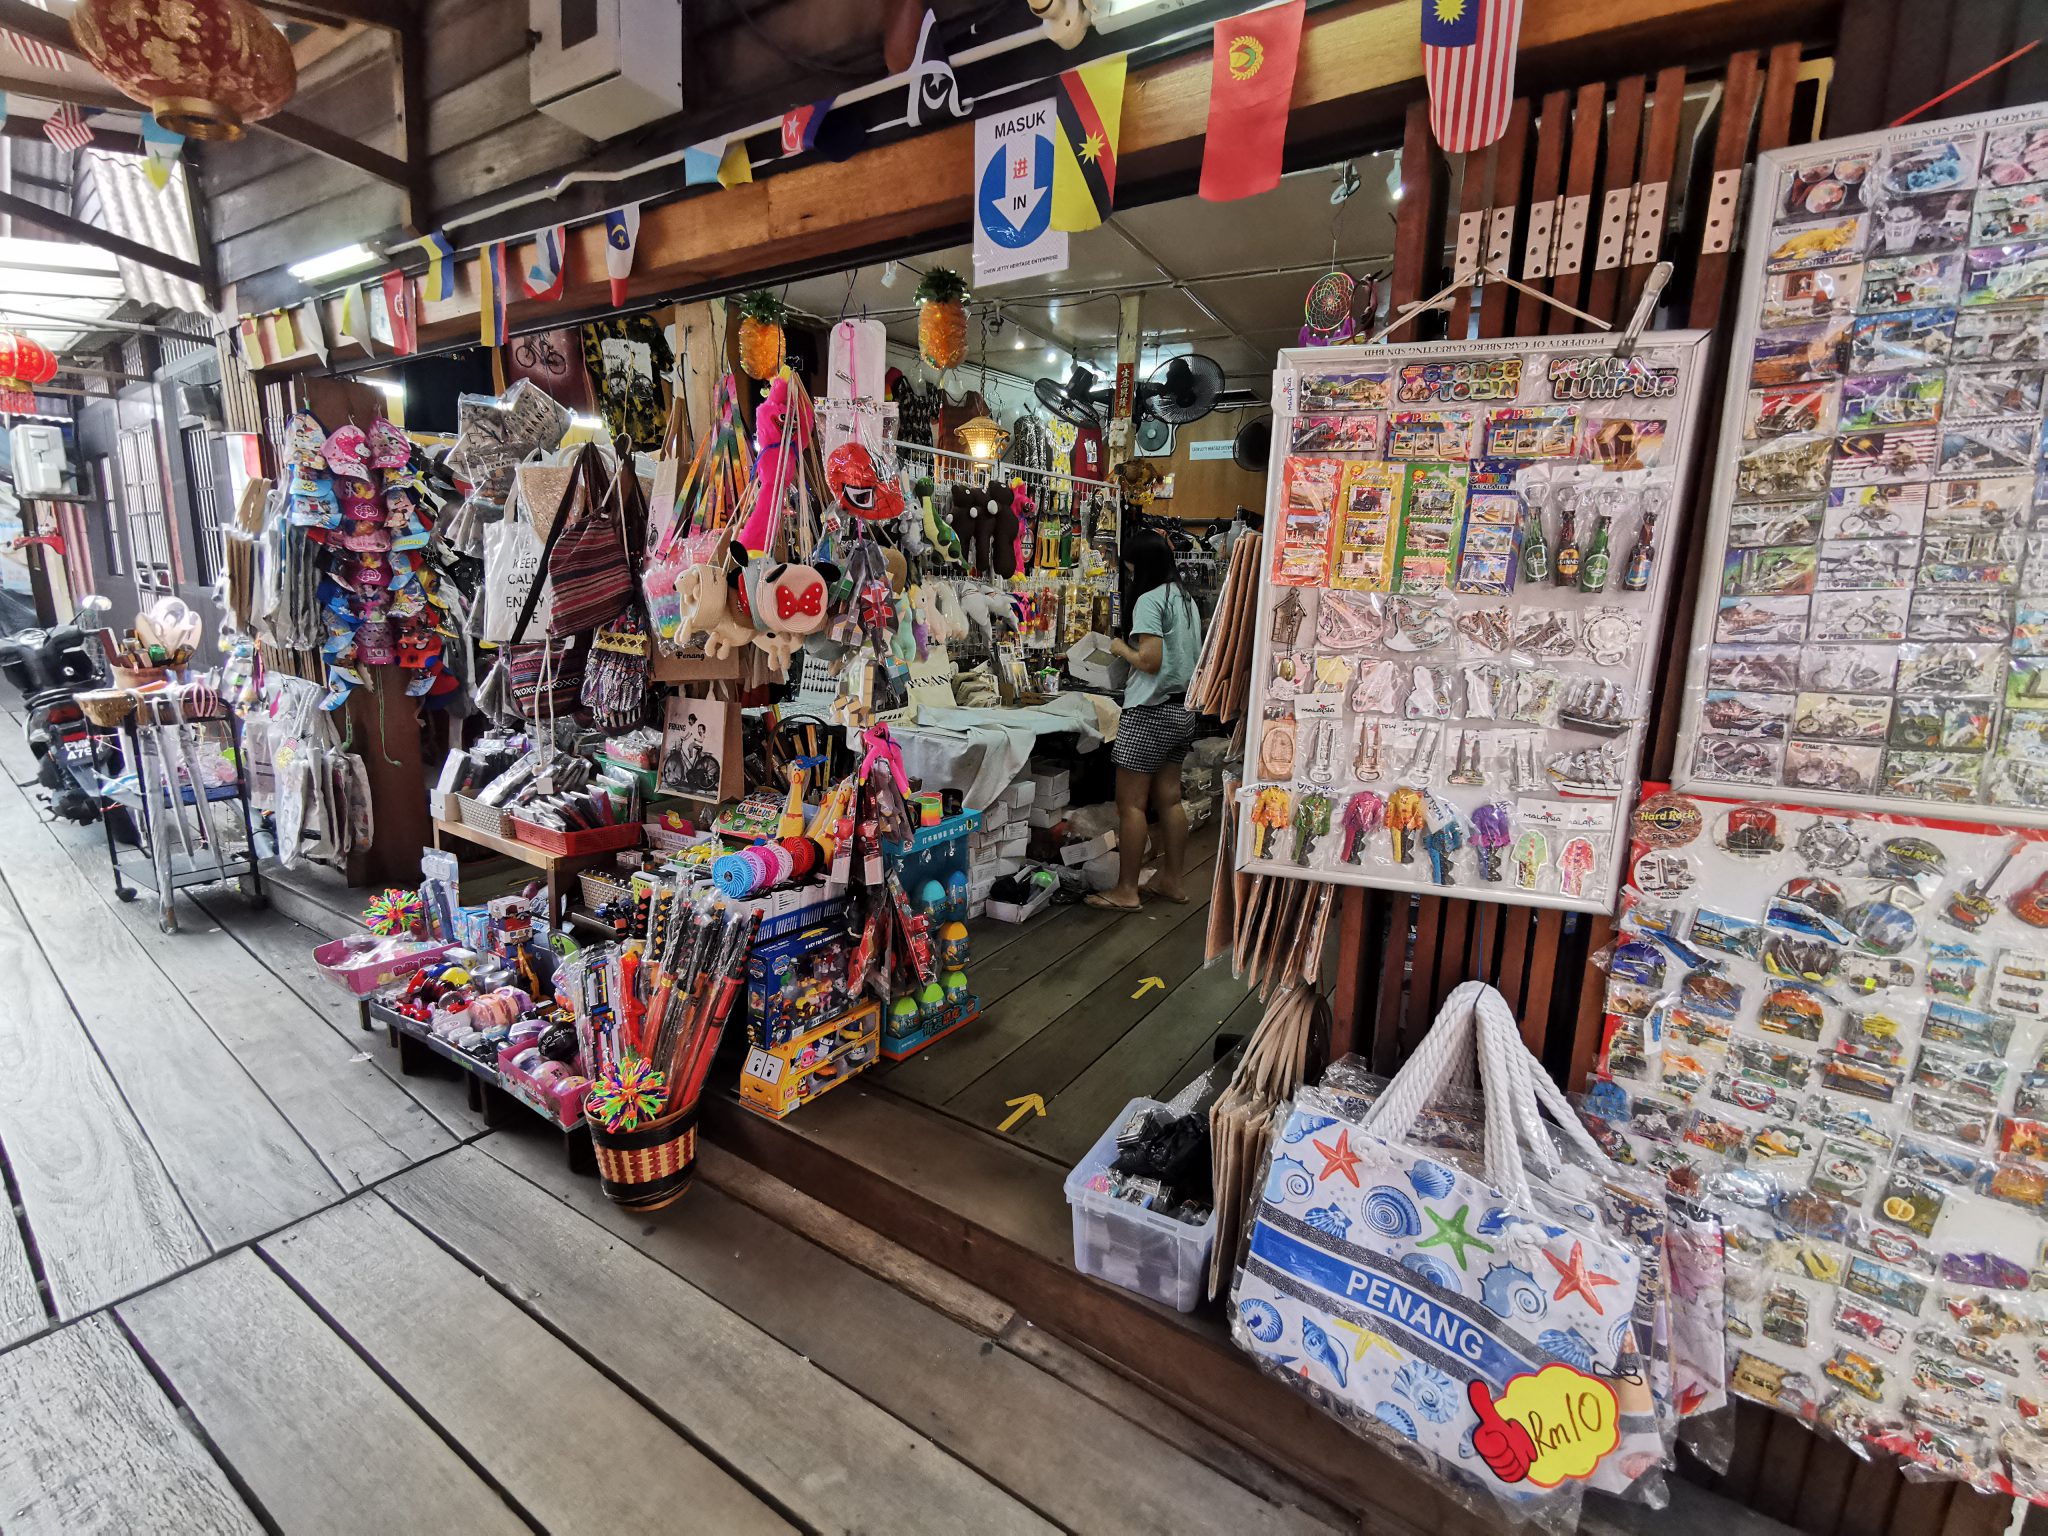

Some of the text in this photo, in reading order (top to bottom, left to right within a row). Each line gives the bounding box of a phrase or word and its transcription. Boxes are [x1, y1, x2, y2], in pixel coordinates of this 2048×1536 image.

[995, 110, 1046, 140] MASUK
[1013, 157, 1028, 180] 进
[1013, 194, 1027, 211] IN
[996, 264, 1009, 272] JETTY
[1009, 260, 1031, 269] HERITAGE
[1470, 341, 1529, 352] CARLSBERG
[1550, 336, 1605, 348] PROPERTY
[1364, 349, 1384, 357] BHD
[1408, 344, 1469, 354] MARKETING
[1423, 359, 1523, 382] GEORGE
[1549, 356, 1650, 381] KUALA
[1437, 378, 1519, 401] TOWN
[1554, 375, 1678, 400] LUMPUR
[513, 557, 537, 569] KEEP
[506, 596, 545, 608] ENY
[515, 611, 538, 624] LE
[676, 651, 705, 661] Penang
[668, 721, 686, 732] PENANG
[1523, 811, 1562, 823] MALAYSIA
[1641, 809, 1696, 821] Hard Rock
[1346, 1269, 1485, 1361] PENANG
